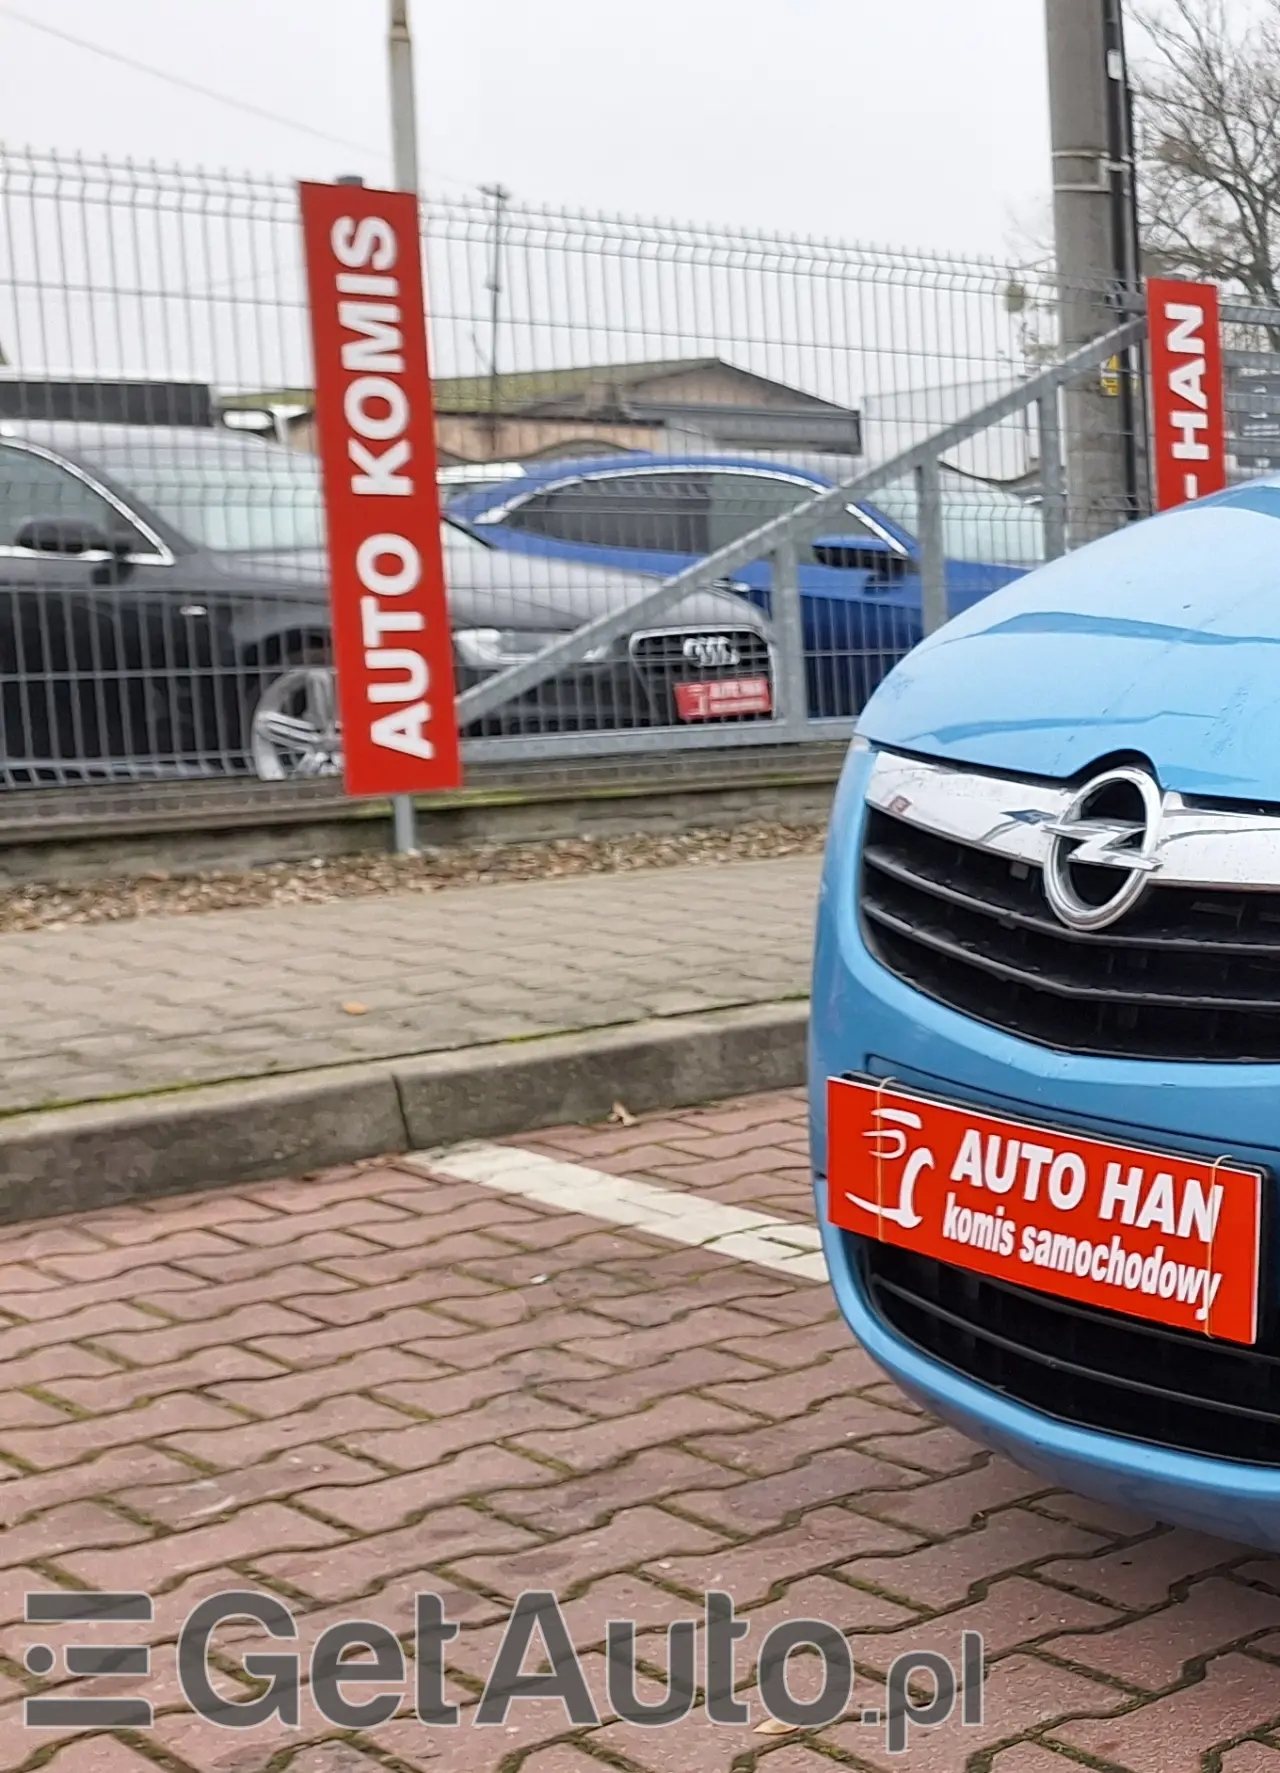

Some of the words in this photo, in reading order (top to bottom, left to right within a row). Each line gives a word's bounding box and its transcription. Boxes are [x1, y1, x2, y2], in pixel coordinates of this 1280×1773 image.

[331, 216, 413, 496] KOMIS
[1164, 303, 1210, 460] HAN
[356, 534, 433, 759] AUTO
[942, 1192, 1016, 1256] komis
[1019, 1226, 1222, 1321] samochodowy
[950, 1129, 1086, 1211] AUTO
[1099, 1162, 1224, 1244] HAN
